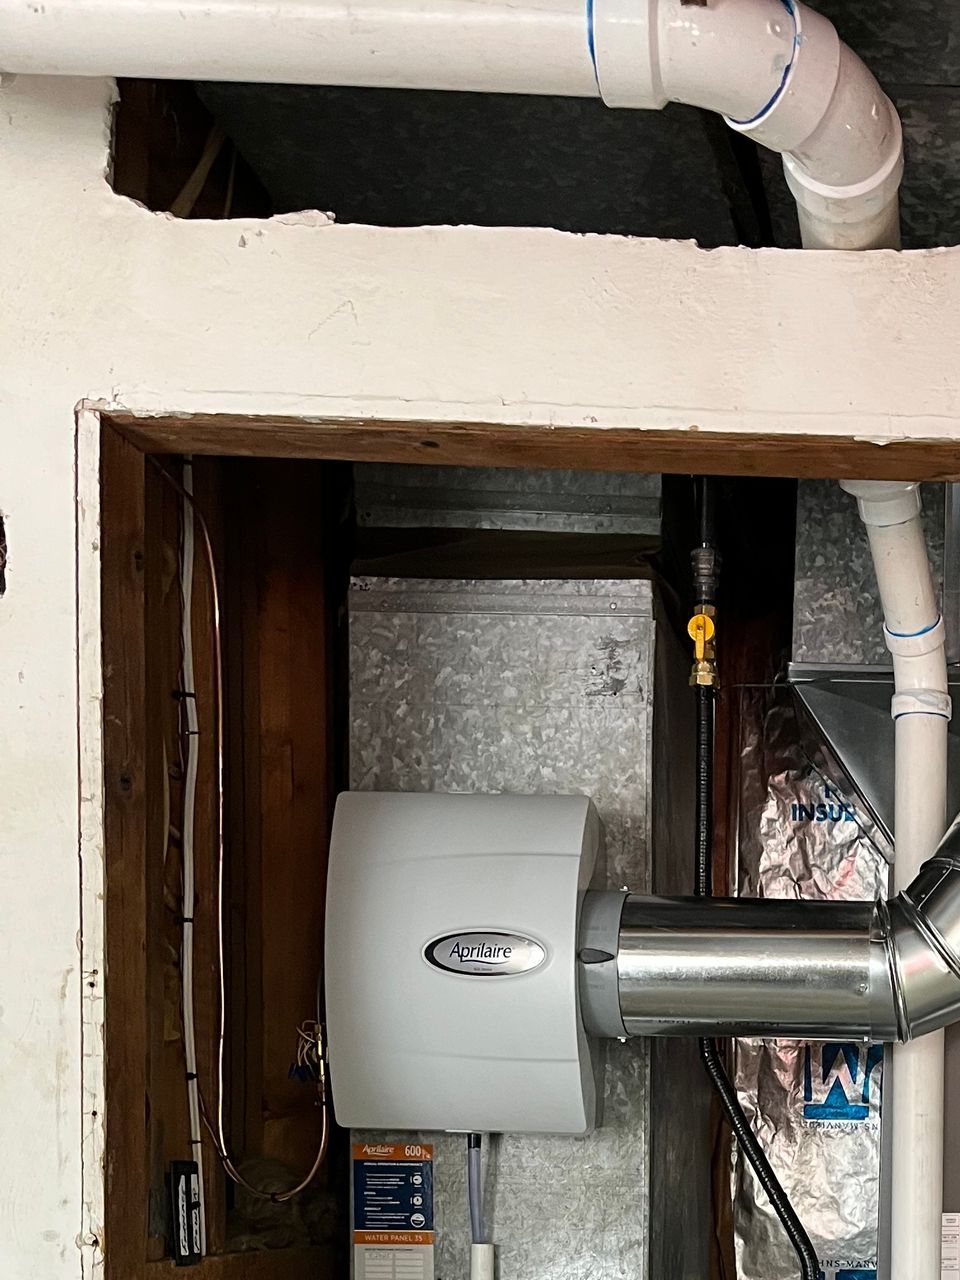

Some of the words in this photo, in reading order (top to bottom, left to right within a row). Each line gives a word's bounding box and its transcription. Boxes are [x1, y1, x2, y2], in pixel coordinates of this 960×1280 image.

[449, 942, 512, 962] Aprilaire
[362, 1144, 395, 1155] Aprilaire
[404, 1145, 421, 1156] 600
[365, 1234, 389, 1242] WATER
[390, 1234, 413, 1242] PANEL
